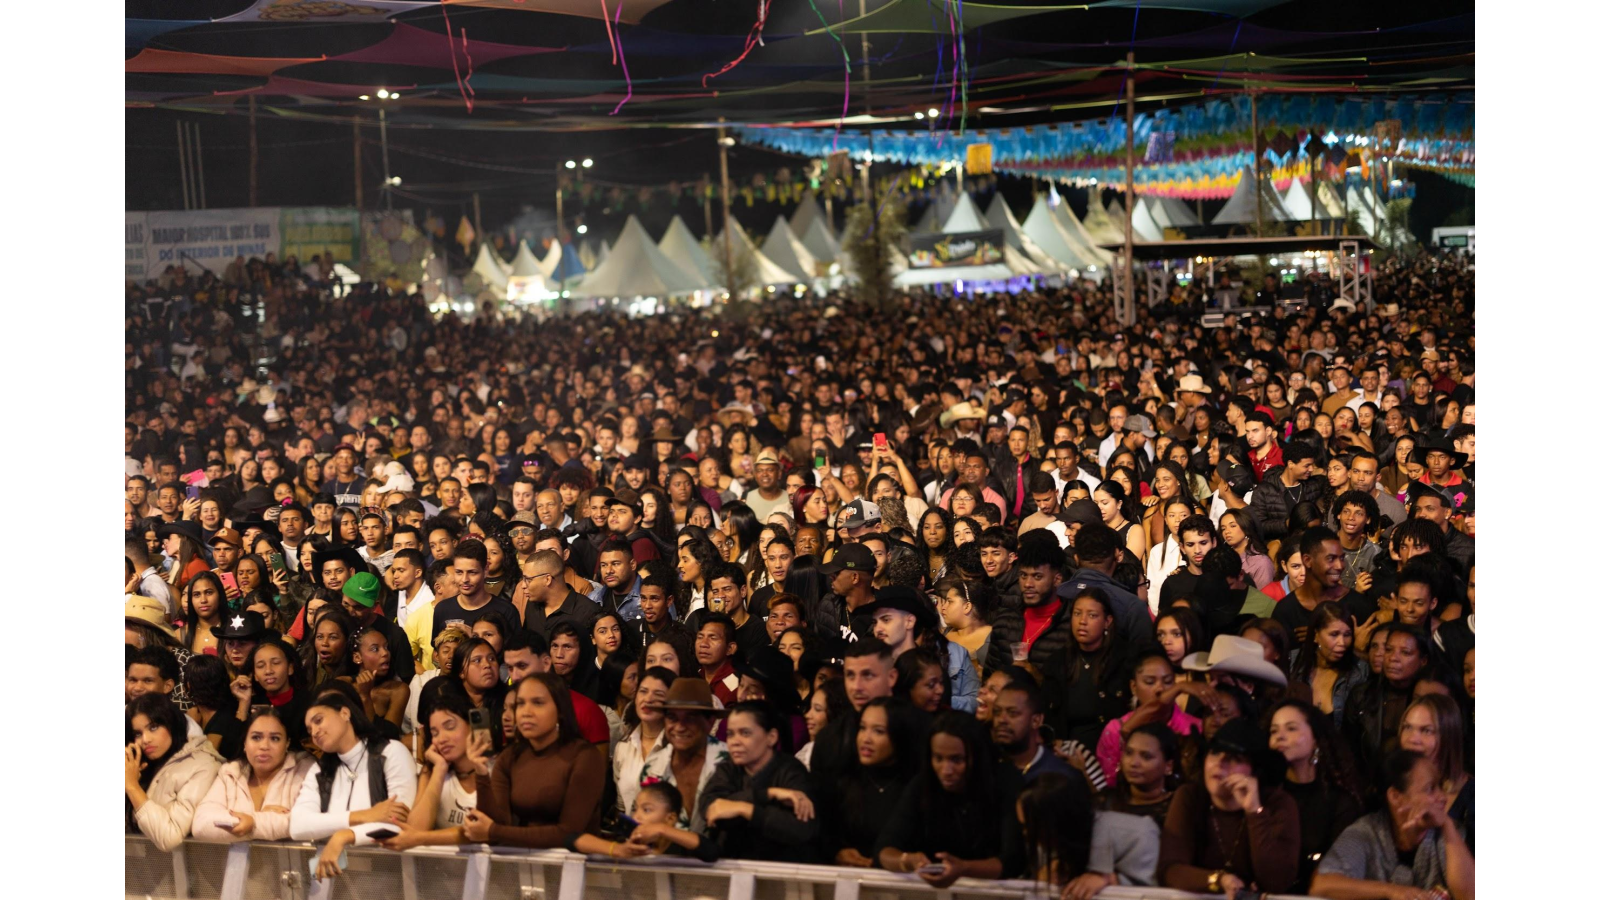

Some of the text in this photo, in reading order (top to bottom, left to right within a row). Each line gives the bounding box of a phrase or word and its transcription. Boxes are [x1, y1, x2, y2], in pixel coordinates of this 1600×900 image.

[152, 228, 185, 244] MAIOR
[187, 225, 228, 243] HOSPITAL
[159, 249, 173, 261] DO
[237, 243, 265, 255] MINAS
